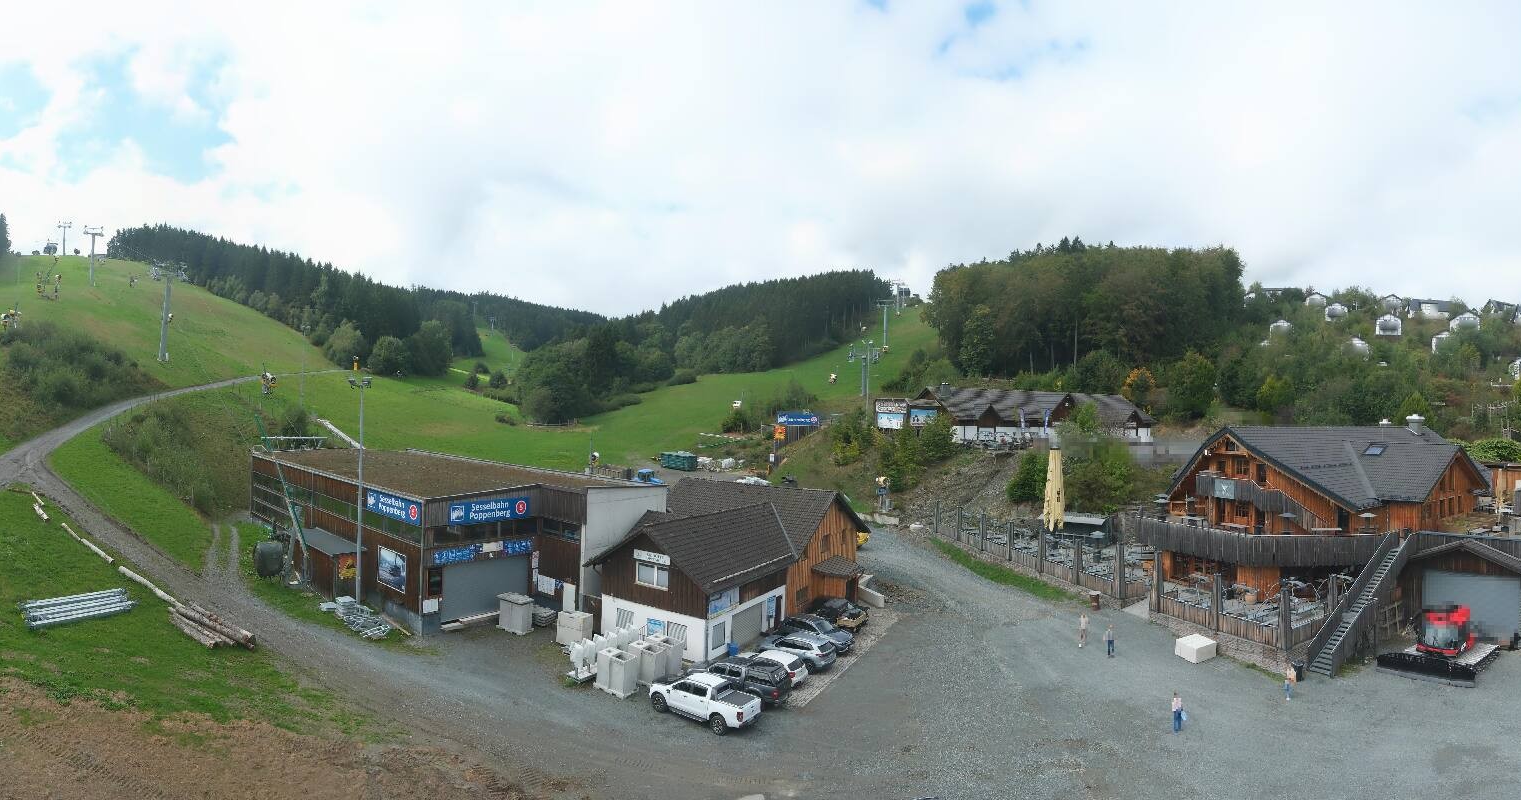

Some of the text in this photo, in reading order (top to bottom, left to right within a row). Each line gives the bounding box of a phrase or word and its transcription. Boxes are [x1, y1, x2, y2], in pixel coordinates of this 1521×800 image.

[379, 494, 405, 509] Sesselbahn
[471, 501, 509, 511] Sesselbahn
[378, 502, 406, 519] Poppenberg
[469, 509, 511, 521] Poppenberg
